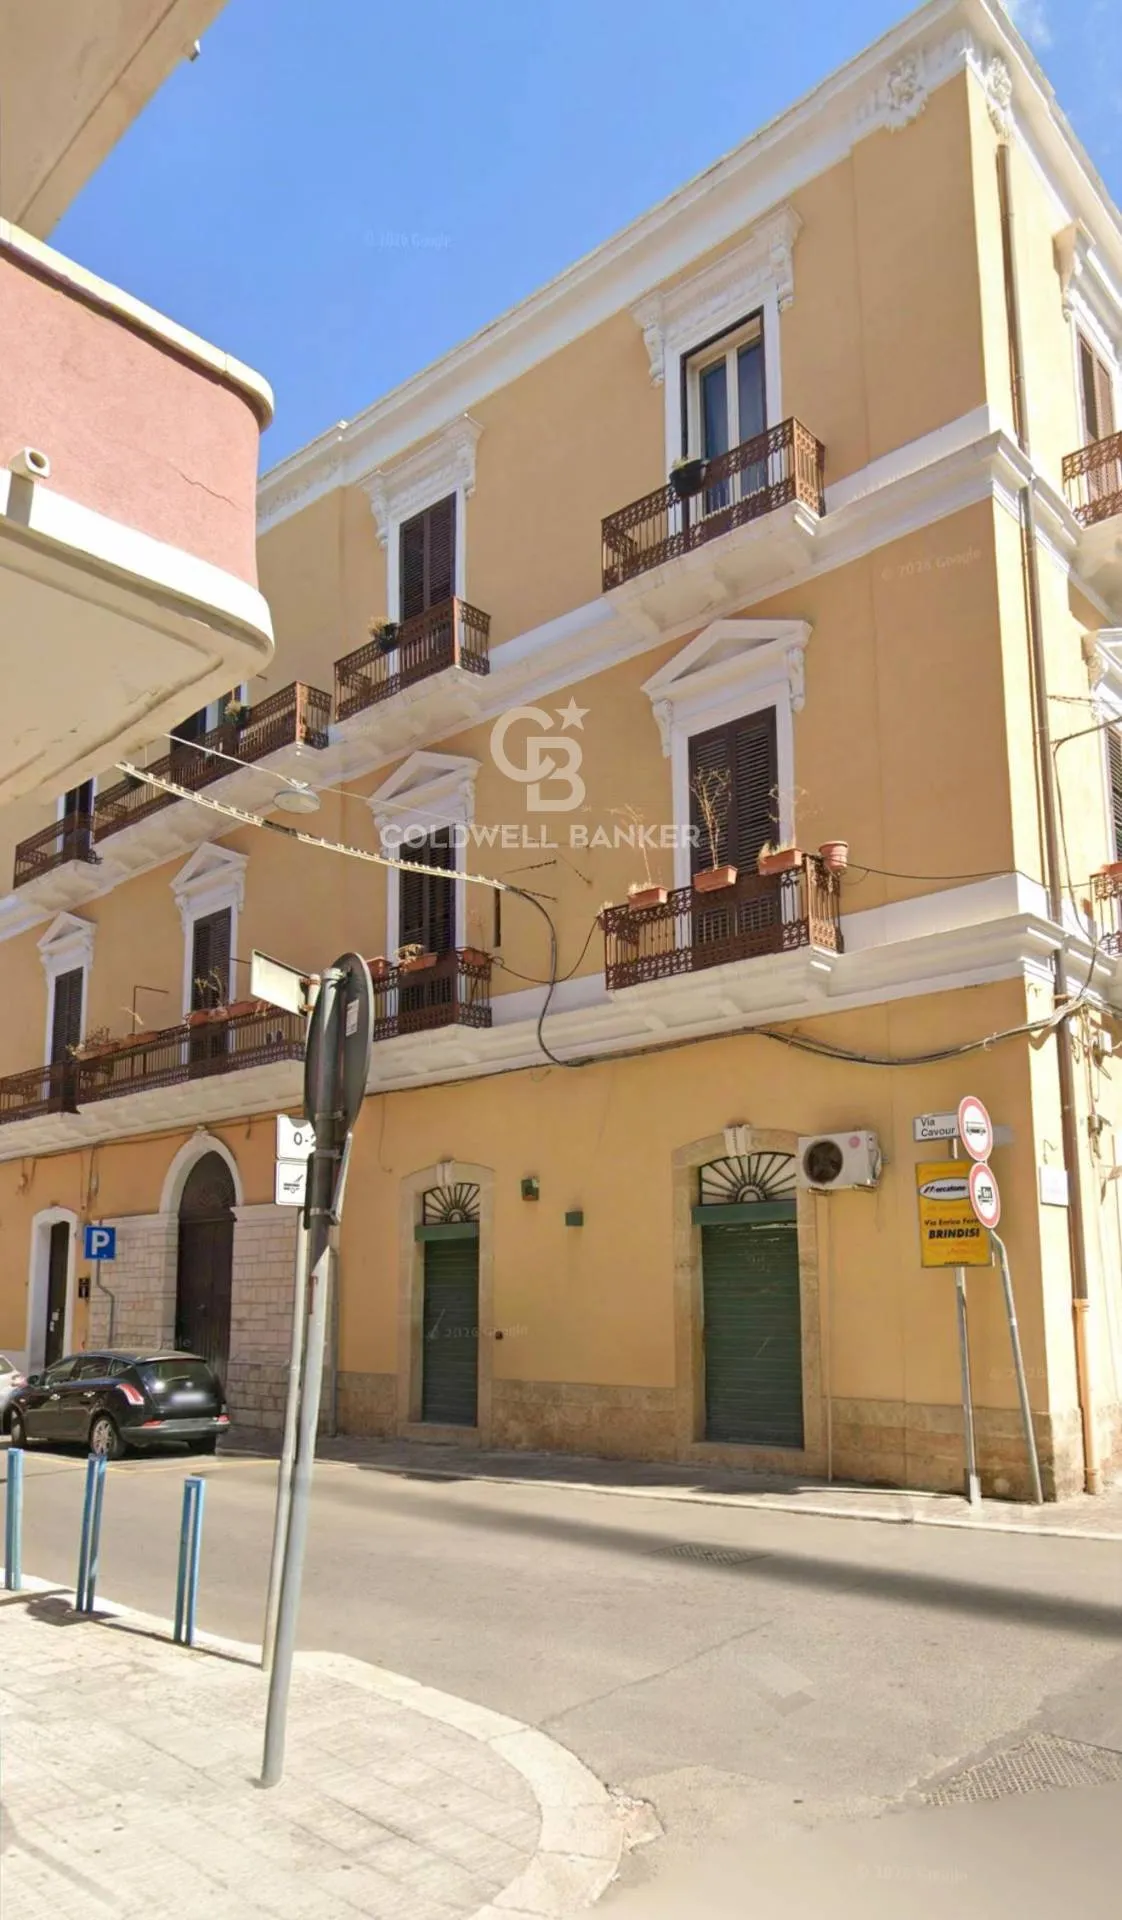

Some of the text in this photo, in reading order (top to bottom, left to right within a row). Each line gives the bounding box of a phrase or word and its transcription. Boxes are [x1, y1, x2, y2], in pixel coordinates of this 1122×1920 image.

[921, 1118, 935, 1127] Via
[921, 1127, 956, 1137] Cavour
[928, 1228, 980, 1239] BRINDISI
[91, 1230, 110, 1256] P
